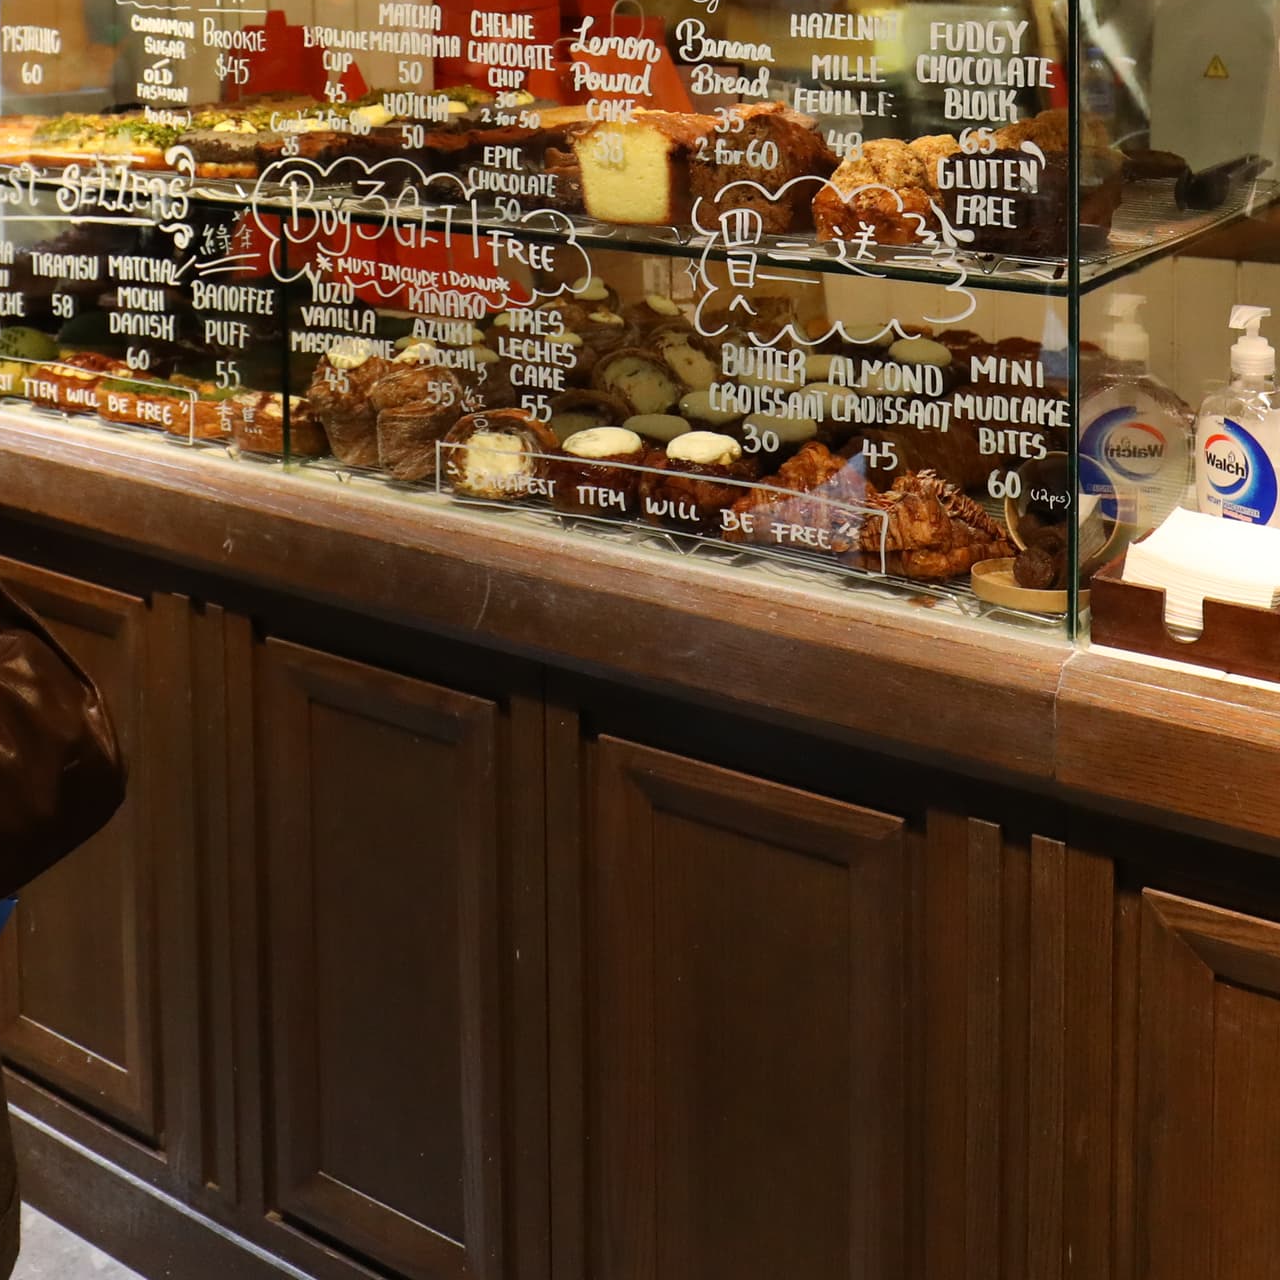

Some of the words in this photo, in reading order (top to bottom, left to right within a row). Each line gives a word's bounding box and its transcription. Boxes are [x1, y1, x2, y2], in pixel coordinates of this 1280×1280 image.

[131, 14, 195, 39] CINNAMON
[378, 3, 442, 31] MATCHA
[470, 9, 535, 40] CHEWIE
[790, 12, 899, 41] HAZELNUT
[144, 36, 186, 60] SUGAR
[203, 17, 267, 53] BROOKIE
[303, 25, 368, 51] BROWNIE
[370, 30, 461, 58] MACADAMIA
[570, 16, 662, 63] Lemon
[676, 18, 775, 63] Banana
[930, 20, 1029, 55] FUDGY
[215, 55, 251, 85] $45
[322, 51, 353, 73] CUP
[467, 40, 556, 71] CHOCOLATE
[811, 54, 886, 83] MILLE
[22, 63, 42, 85] 60
[143, 67, 173, 86] OLD
[398, 60, 423, 85] 50
[488, 67, 525, 89] CHIP
[570, 61, 652, 96] Pound
[690, 64, 770, 98] Bread
[916, 54, 1056, 89] CHOCOLATE
[137, 83, 187, 103] FASHION
[324, 80, 347, 104] 45
[383, 92, 449, 122] HOJICHA
[793, 87, 897, 118] FEUILLE
[943, 88, 1020, 124] BLOCK
[480, 107, 491, 124] 2
[493, 110, 518, 128] for
[518, 111, 541, 130] 50
[586, 98, 638, 124] CAKE
[714, 107, 744, 134] 35
[281, 135, 299, 157] 35
[401, 124, 425, 150] 50
[827, 129, 863, 162] 48
[959, 127, 997, 155] 65
[483, 146, 523, 171] EPIC
[695, 137, 711, 161] 2
[714, 140, 744, 165] for
[746, 139, 779, 170] 60
[468, 166, 558, 198] CHOCOLATE
[936, 157, 1039, 194] GLUTEN
[357, 179, 390, 241] 3
[393, 184, 457, 249] GET
[471, 198, 480, 259] 1
[485, 228, 556, 273] FREE
[493, 199, 521, 223] 50
[955, 194, 1017, 229] FREE
[29, 251, 99, 281] TIRAMISU
[108, 255, 175, 284] MATCHA
[337, 257, 376, 277] MUST
[378, 263, 439, 288] INCLUDE
[51, 293, 74, 319] 58
[117, 286, 165, 313] MOCHI
[191, 279, 275, 316] BANOFFEE
[408, 287, 486, 320] KINAKO
[109, 312, 175, 342] DANISH
[205, 318, 250, 349] PUFF
[301, 305, 376, 335] VANILLA
[412, 317, 474, 345] AZUKI
[505, 306, 565, 337] TRES
[126, 346, 150, 371] 60
[291, 330, 395, 361] MASCARPONE
[420, 344, 475, 371] MOCHI
[498, 335, 578, 370] LECHES
[215, 359, 241, 392] 55
[509, 362, 566, 393] CAKE
[721, 342, 807, 387] BUTTER
[828, 355, 944, 397] ALMOND
[970, 355, 1045, 389] MINI
[324, 366, 350, 394] 45
[426, 380, 455, 407] 55
[22, 377, 59, 403] ITEM
[66, 387, 100, 408] WILL
[108, 393, 129, 414] BE
[520, 394, 553, 423] 55
[708, 381, 828, 422] CROISSANT
[954, 392, 1072, 427] MUDCAKE
[831, 393, 953, 432] CROISSANT
[742, 423, 780, 453] 30
[978, 426, 1047, 460] BITES
[862, 438, 898, 471] 45
[1205, 450, 1247, 479] Walch
[987, 470, 1021, 499] 60
[1030, 488, 1072, 511] (12pcs)
[576, 485, 626, 512] ITEM
[646, 497, 700, 522] WILL
[719, 509, 754, 535] BE
